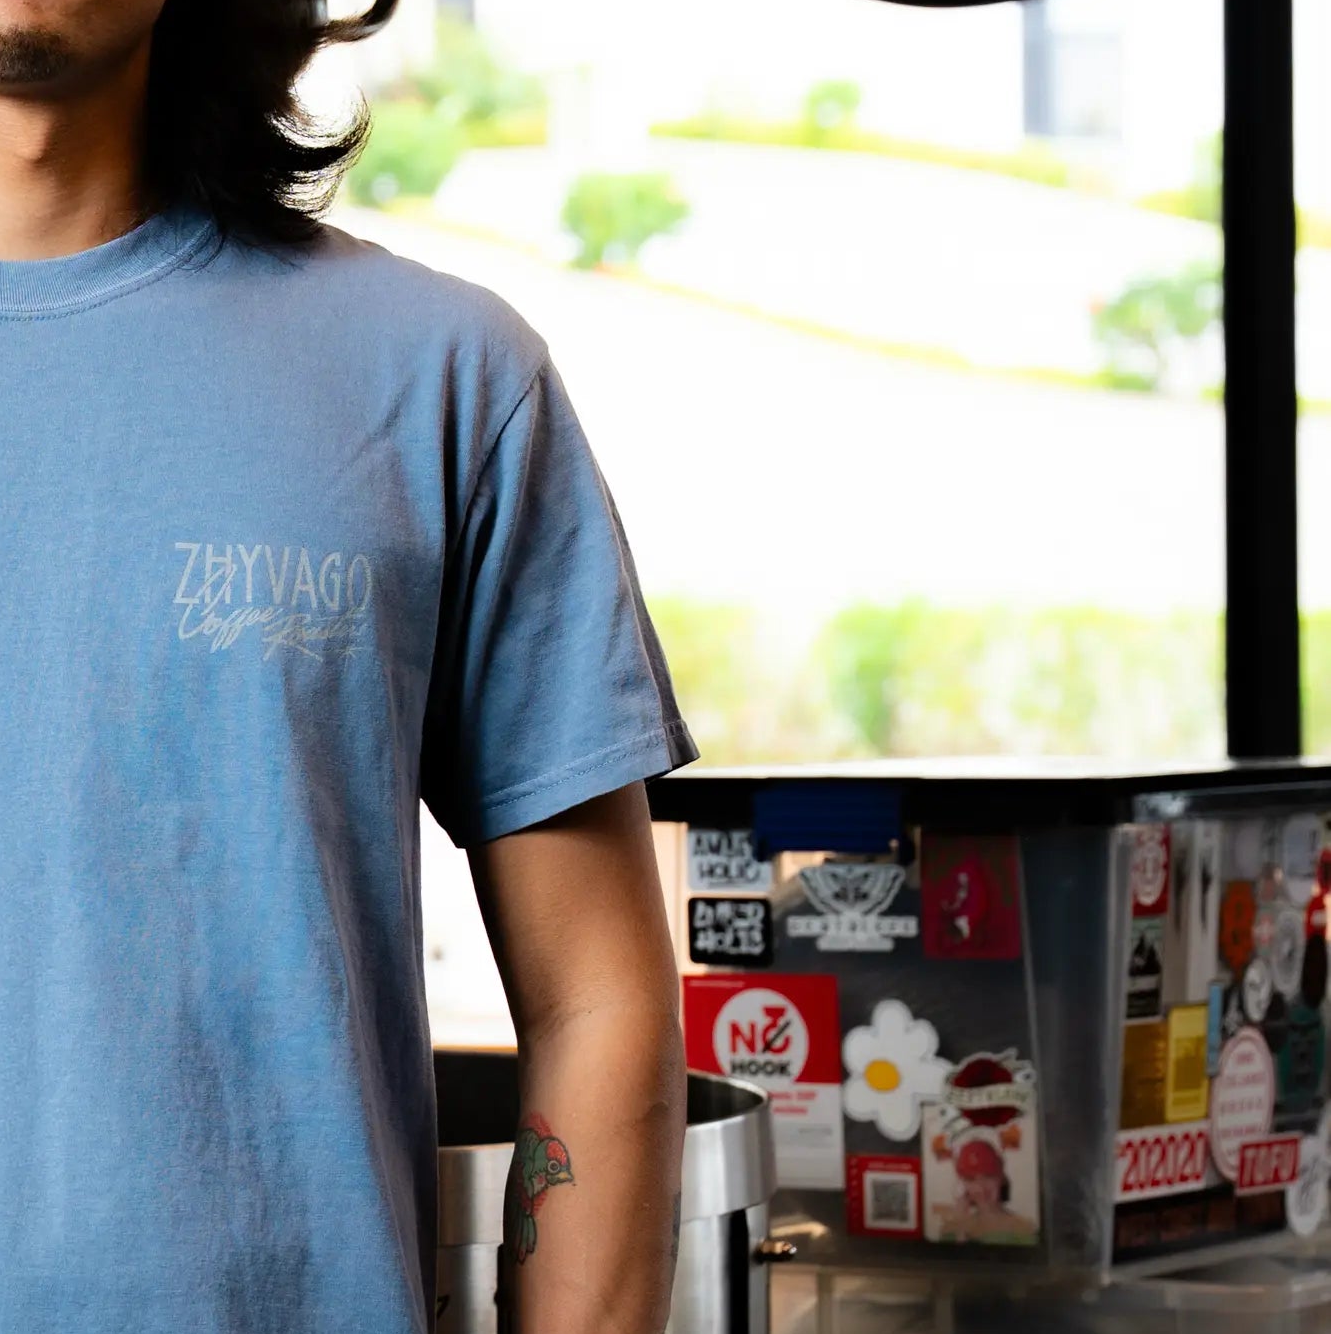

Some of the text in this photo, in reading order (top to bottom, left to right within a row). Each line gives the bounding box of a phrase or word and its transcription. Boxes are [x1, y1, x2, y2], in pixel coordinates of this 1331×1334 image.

[173, 542, 373, 611] ZHYVAGO
[730, 1060, 791, 1077] HOOK
[1242, 1141, 1297, 1186] TOFU
